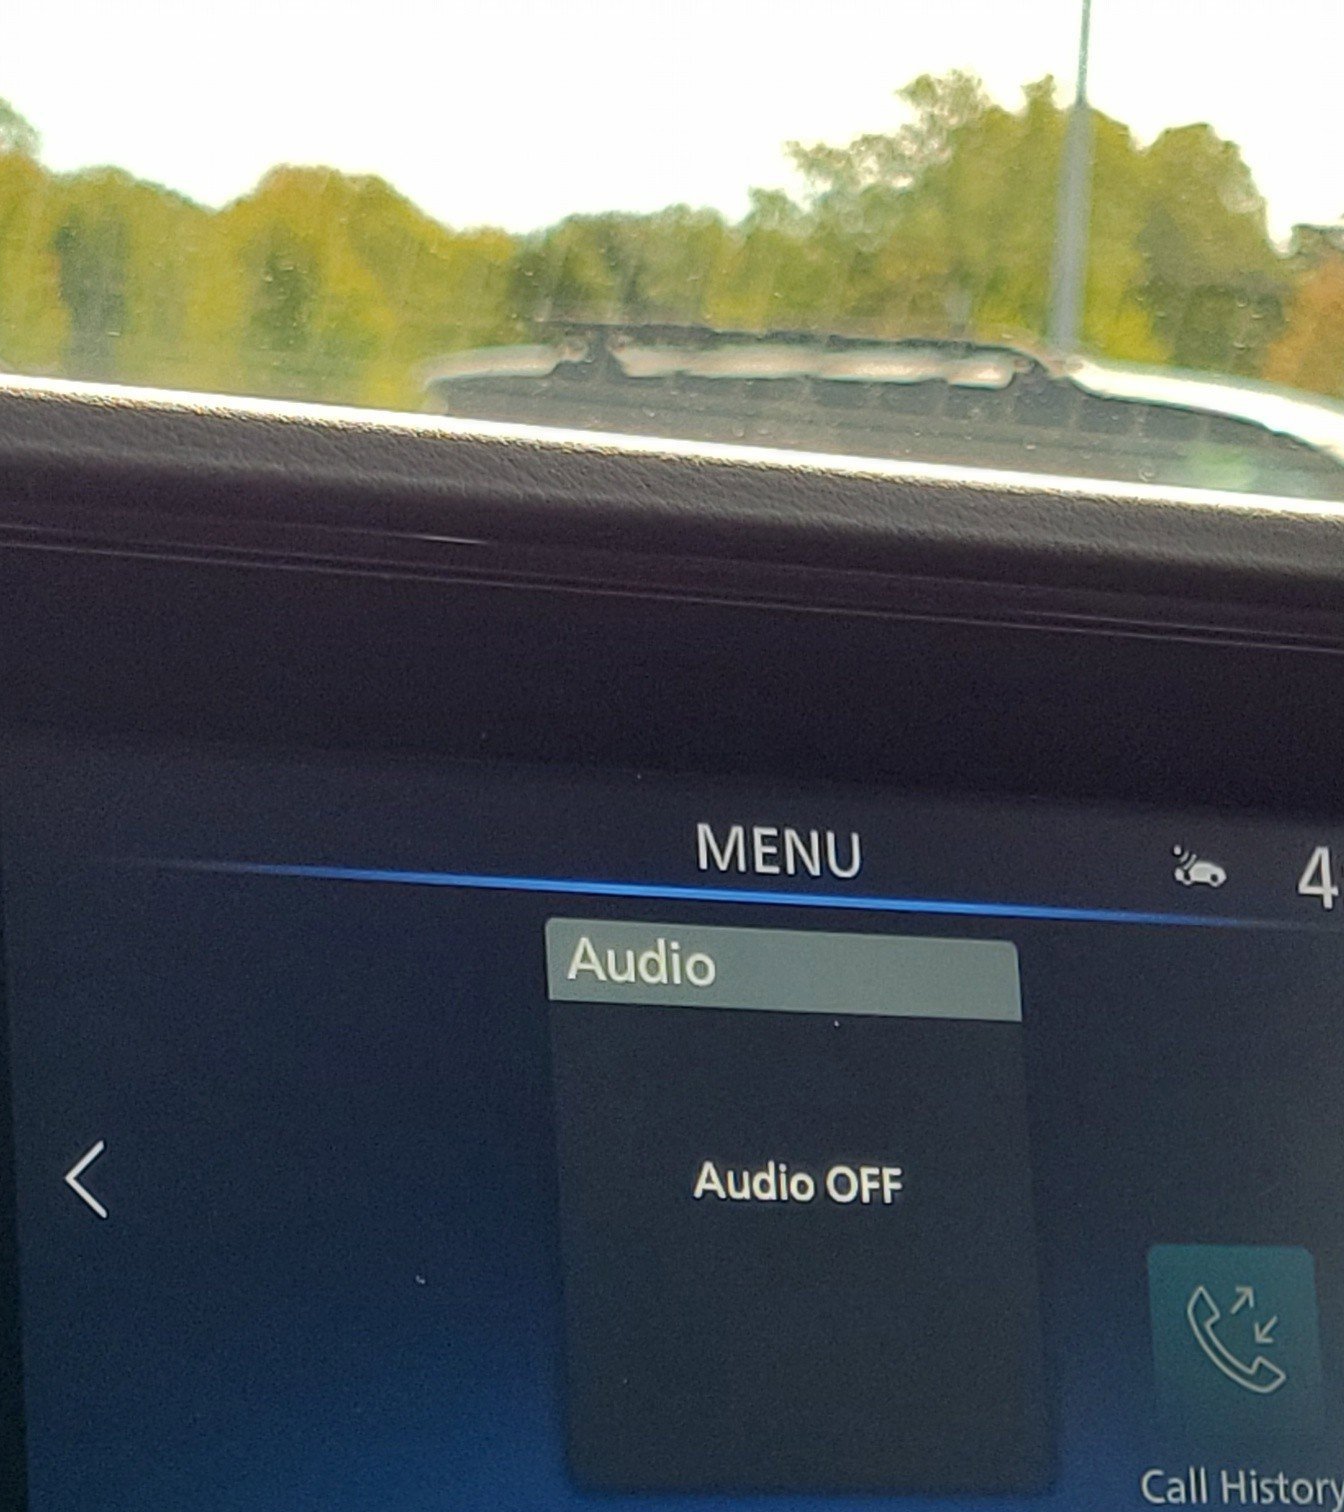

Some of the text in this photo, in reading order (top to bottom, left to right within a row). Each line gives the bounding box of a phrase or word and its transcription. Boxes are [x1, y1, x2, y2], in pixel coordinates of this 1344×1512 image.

[696, 822, 862, 880] MENU
[567, 936, 716, 986] Audio
[693, 1160, 902, 1204] Audio OFF
[1141, 1466, 1208, 1505] Call
